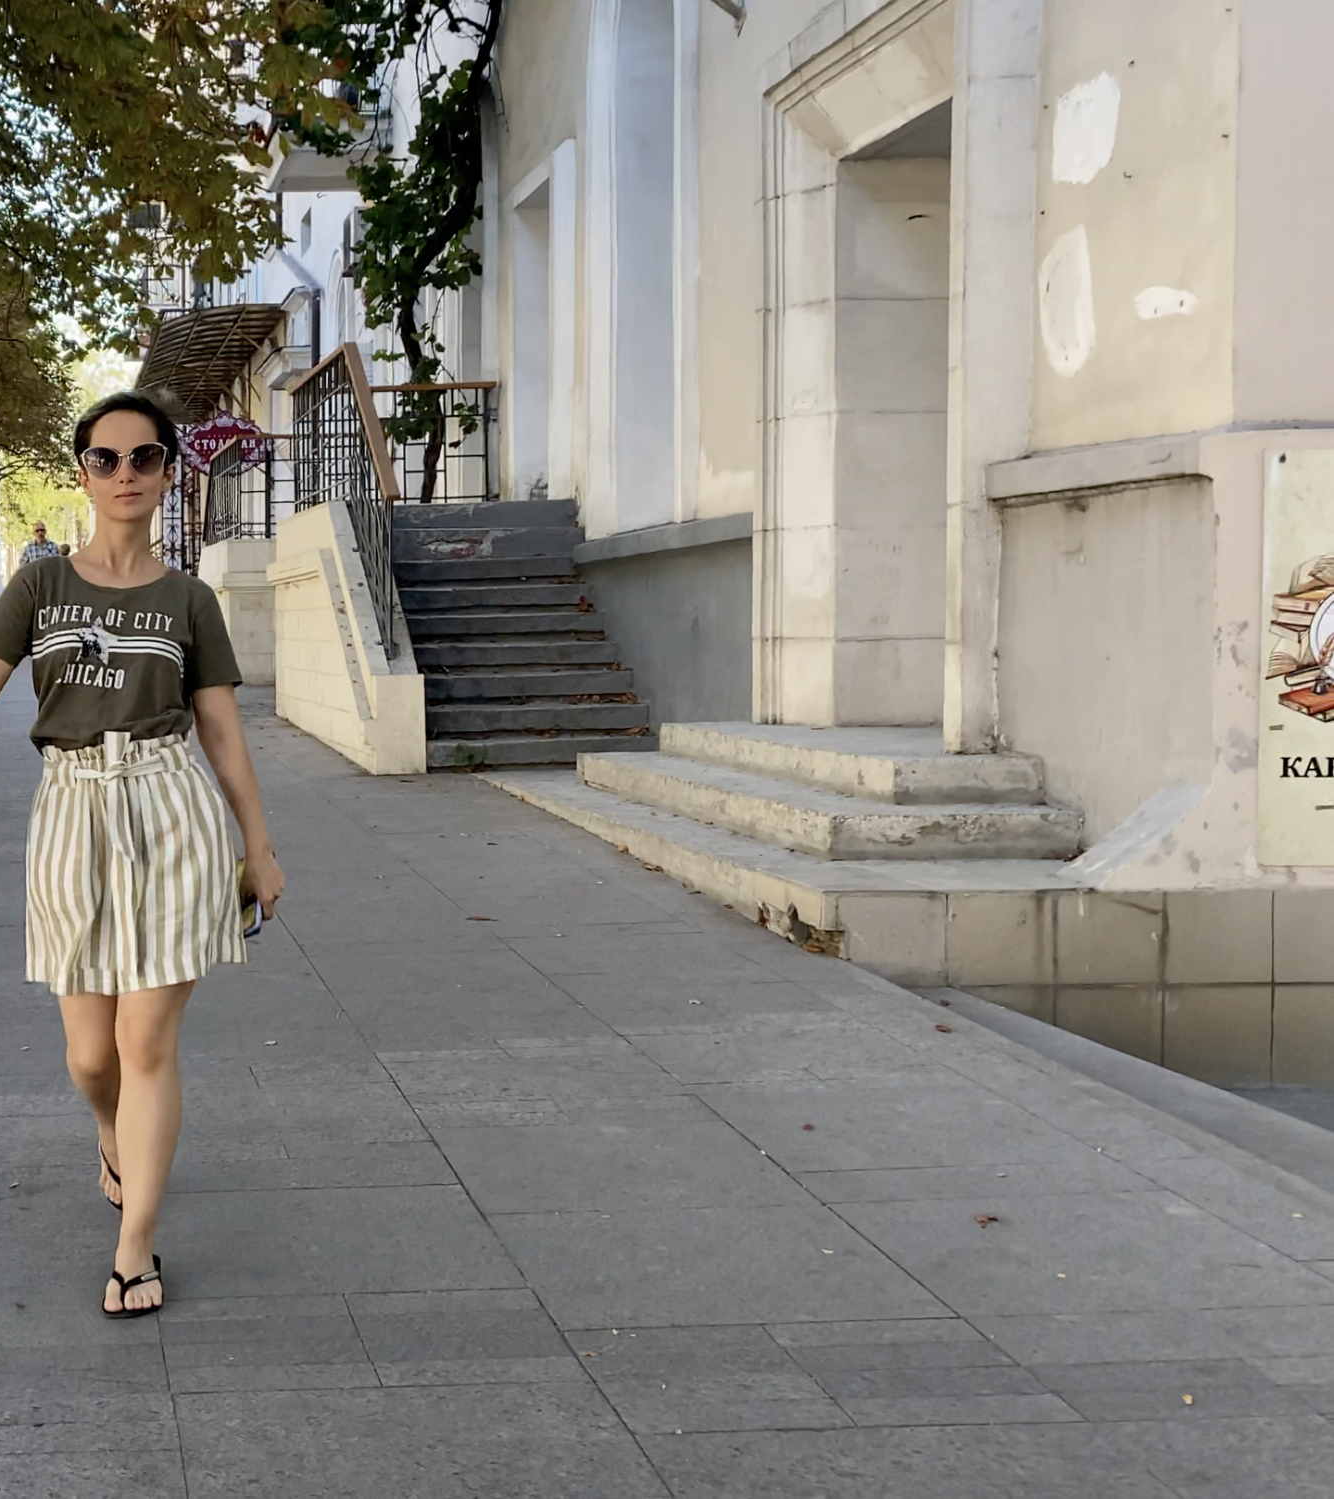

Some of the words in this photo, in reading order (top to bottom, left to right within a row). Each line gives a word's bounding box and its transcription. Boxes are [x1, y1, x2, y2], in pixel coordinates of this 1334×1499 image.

[105, 608, 127, 628] OF
[133, 612, 174, 632] CITY
[55, 663, 125, 689] HICAGO
